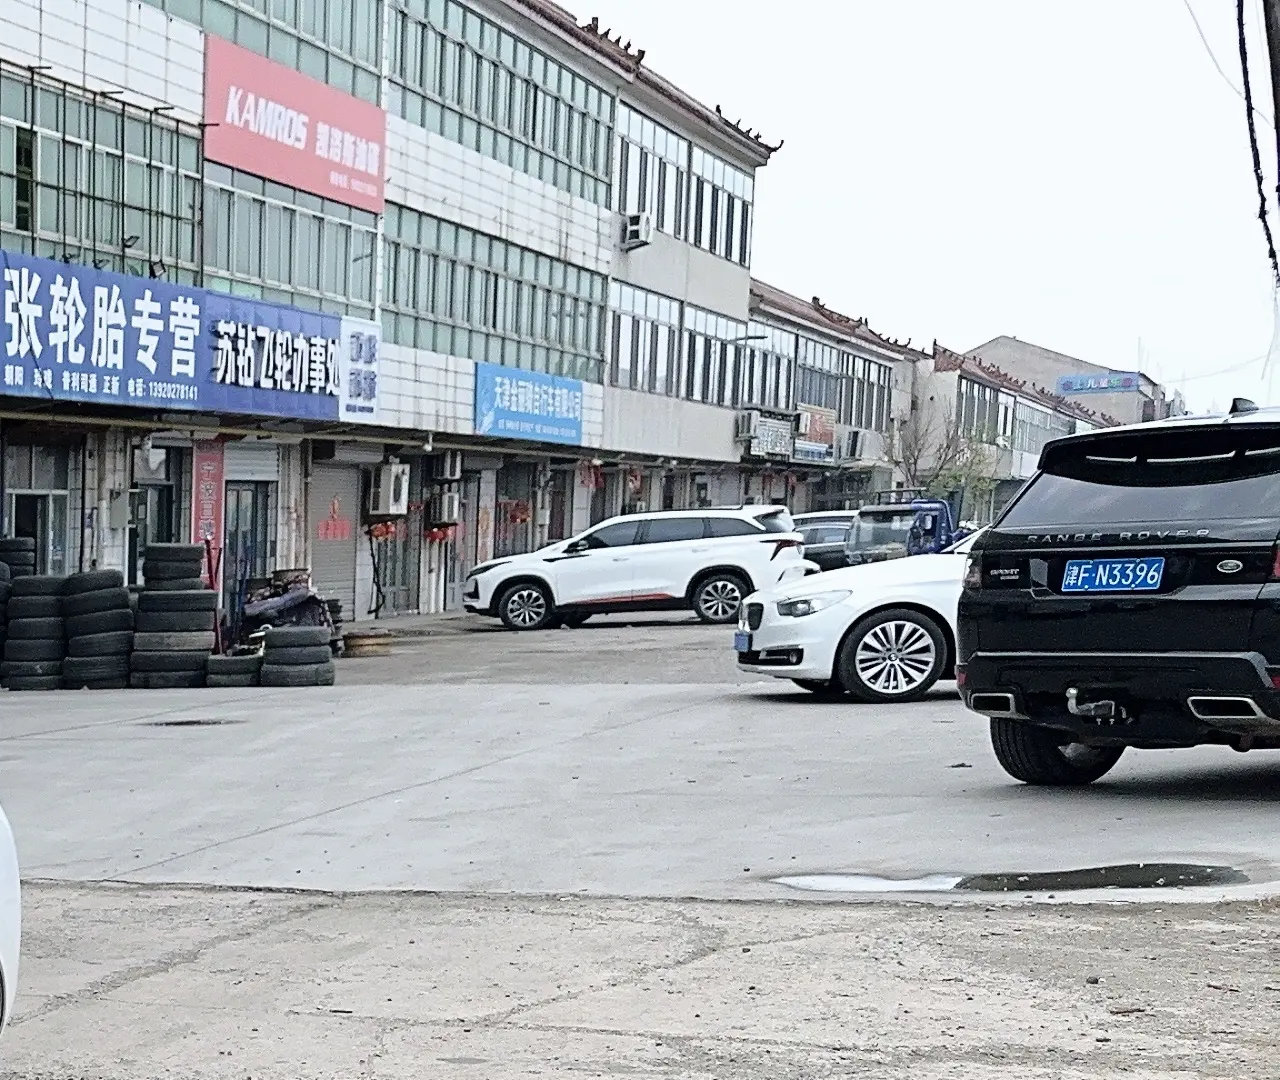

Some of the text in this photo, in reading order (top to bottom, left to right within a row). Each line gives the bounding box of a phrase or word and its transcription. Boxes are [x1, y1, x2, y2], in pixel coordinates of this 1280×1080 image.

[225, 85, 309, 150] KAMROS
[62, 370, 97, 394] 普利司通
[103, 375, 120, 396] 正新
[1027, 529, 1211, 543] RANGE ROVER
